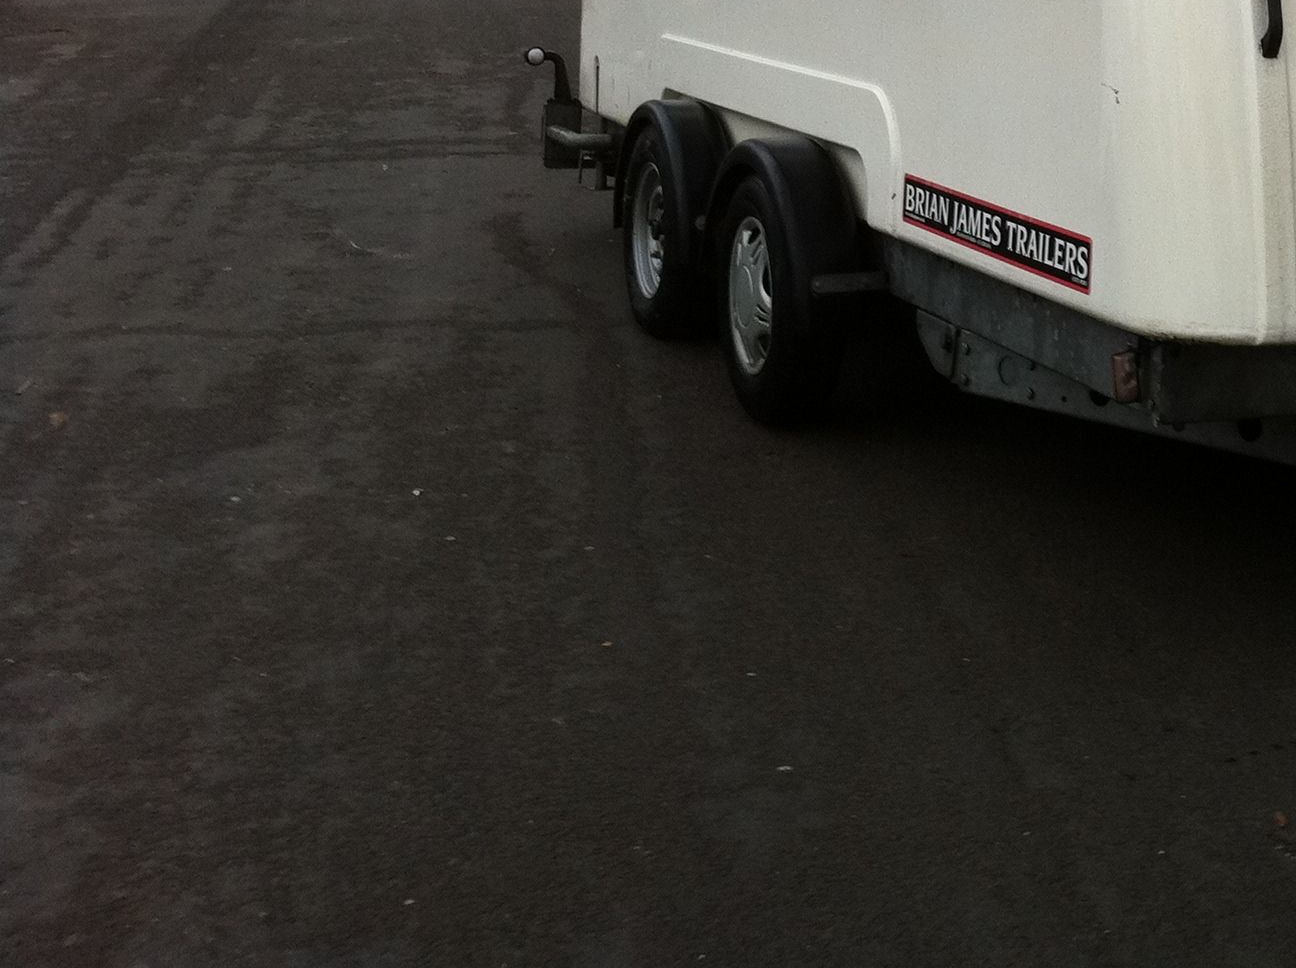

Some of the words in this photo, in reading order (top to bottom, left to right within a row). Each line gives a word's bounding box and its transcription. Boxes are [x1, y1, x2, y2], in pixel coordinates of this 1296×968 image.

[905, 183, 950, 226] BRIAN
[950, 200, 1002, 247] JAMES
[1006, 220, 1089, 279] TRAILERS
